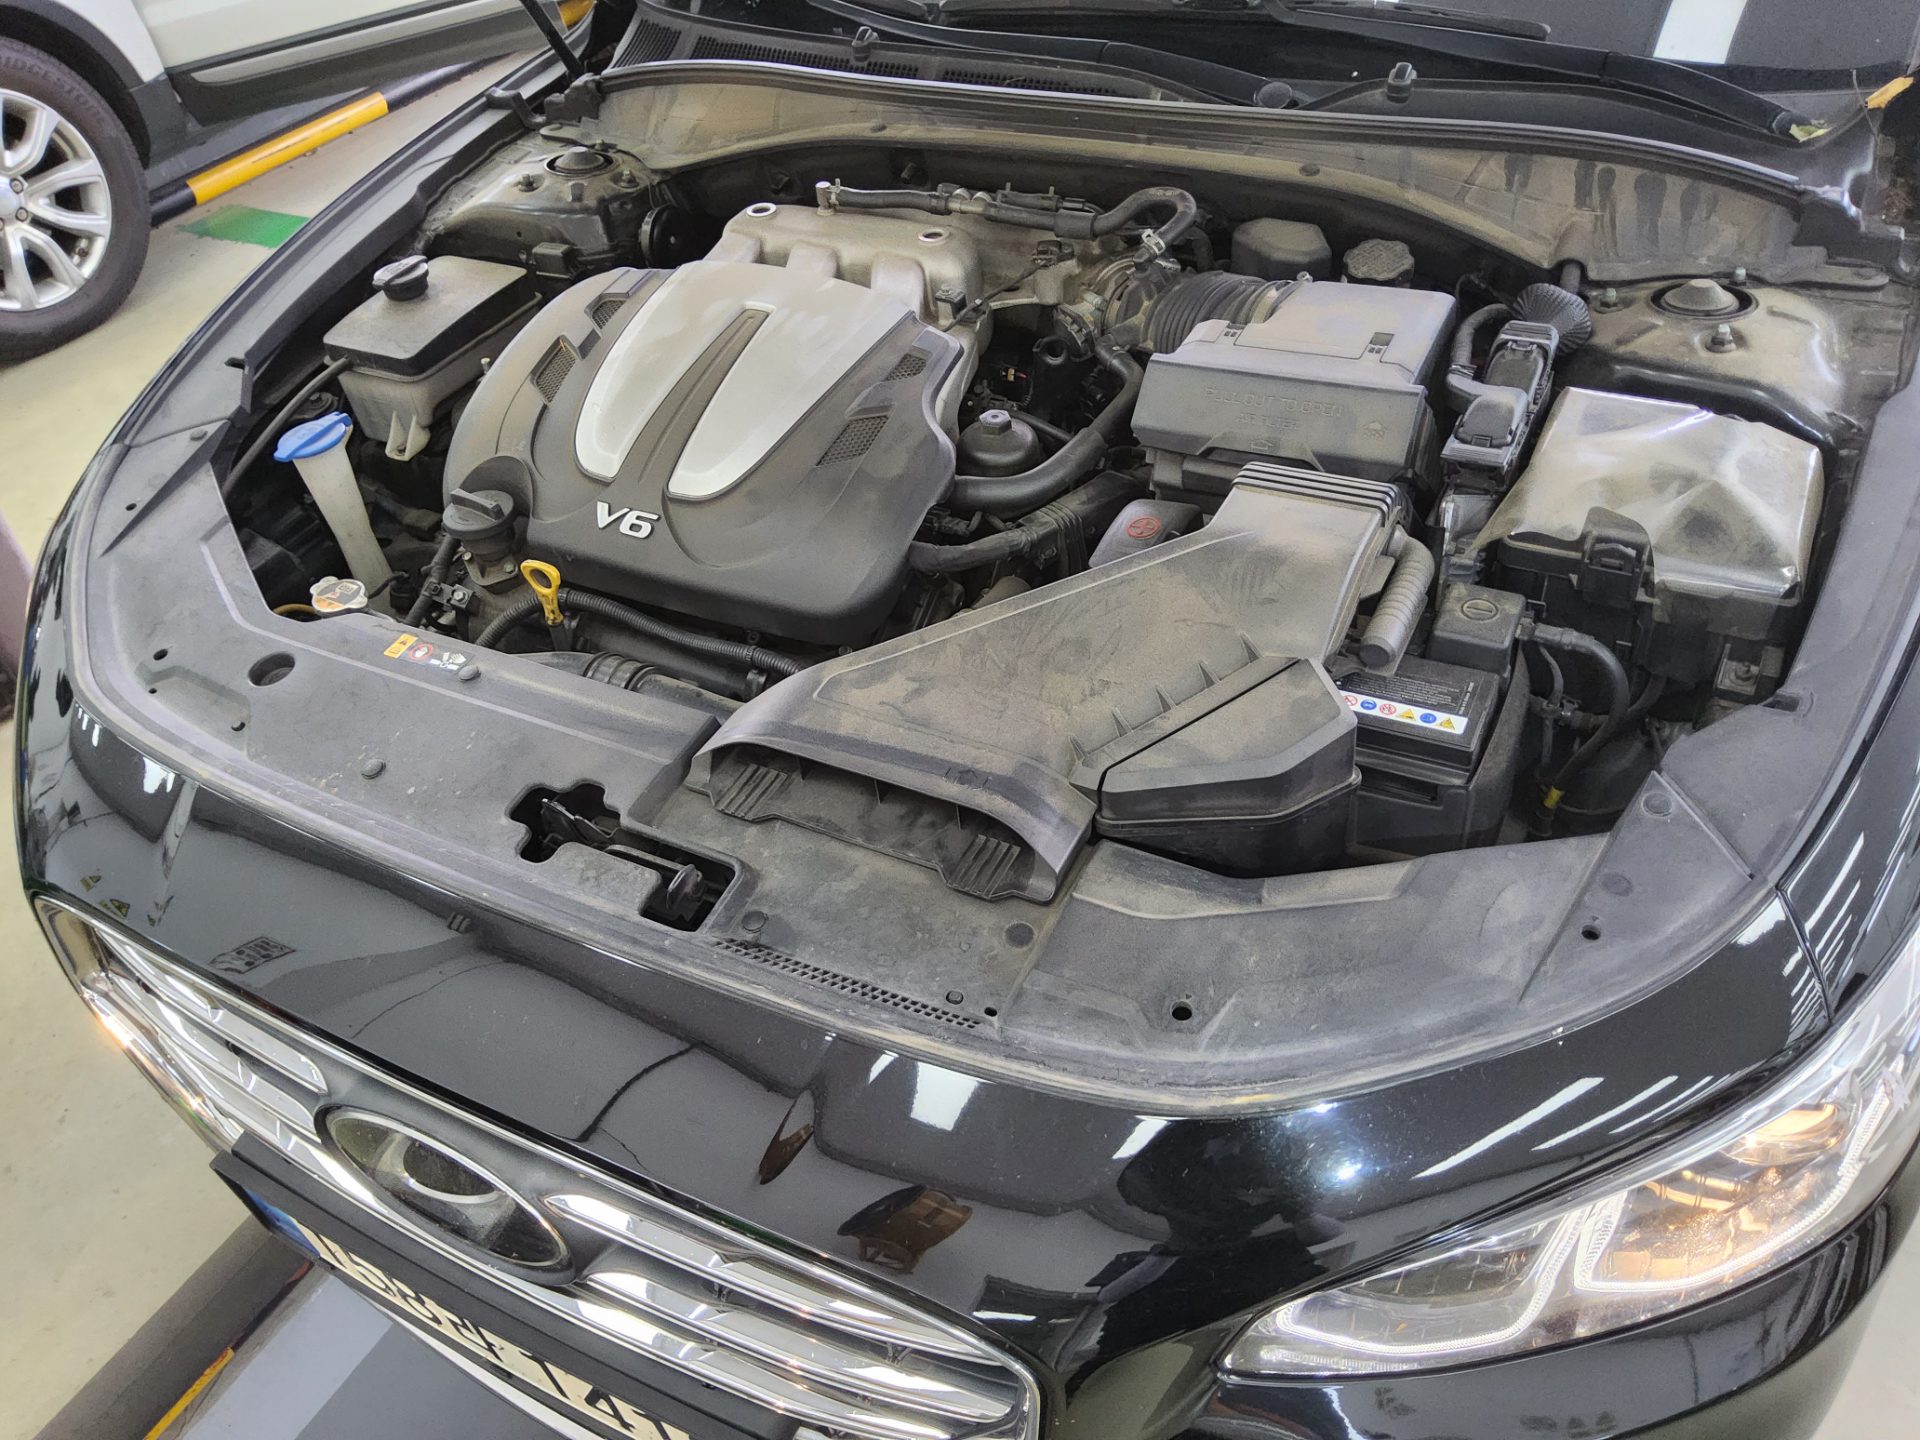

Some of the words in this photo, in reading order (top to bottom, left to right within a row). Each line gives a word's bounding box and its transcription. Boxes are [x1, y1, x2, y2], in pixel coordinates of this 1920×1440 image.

[0, 55, 105, 126] IDGESTONE
[1205, 386, 1240, 405] PULL
[1245, 393, 1275, 407] OUT
[1280, 397, 1297, 411] TO
[1302, 400, 1343, 417] OPEN
[596, 500, 660, 539] V6
